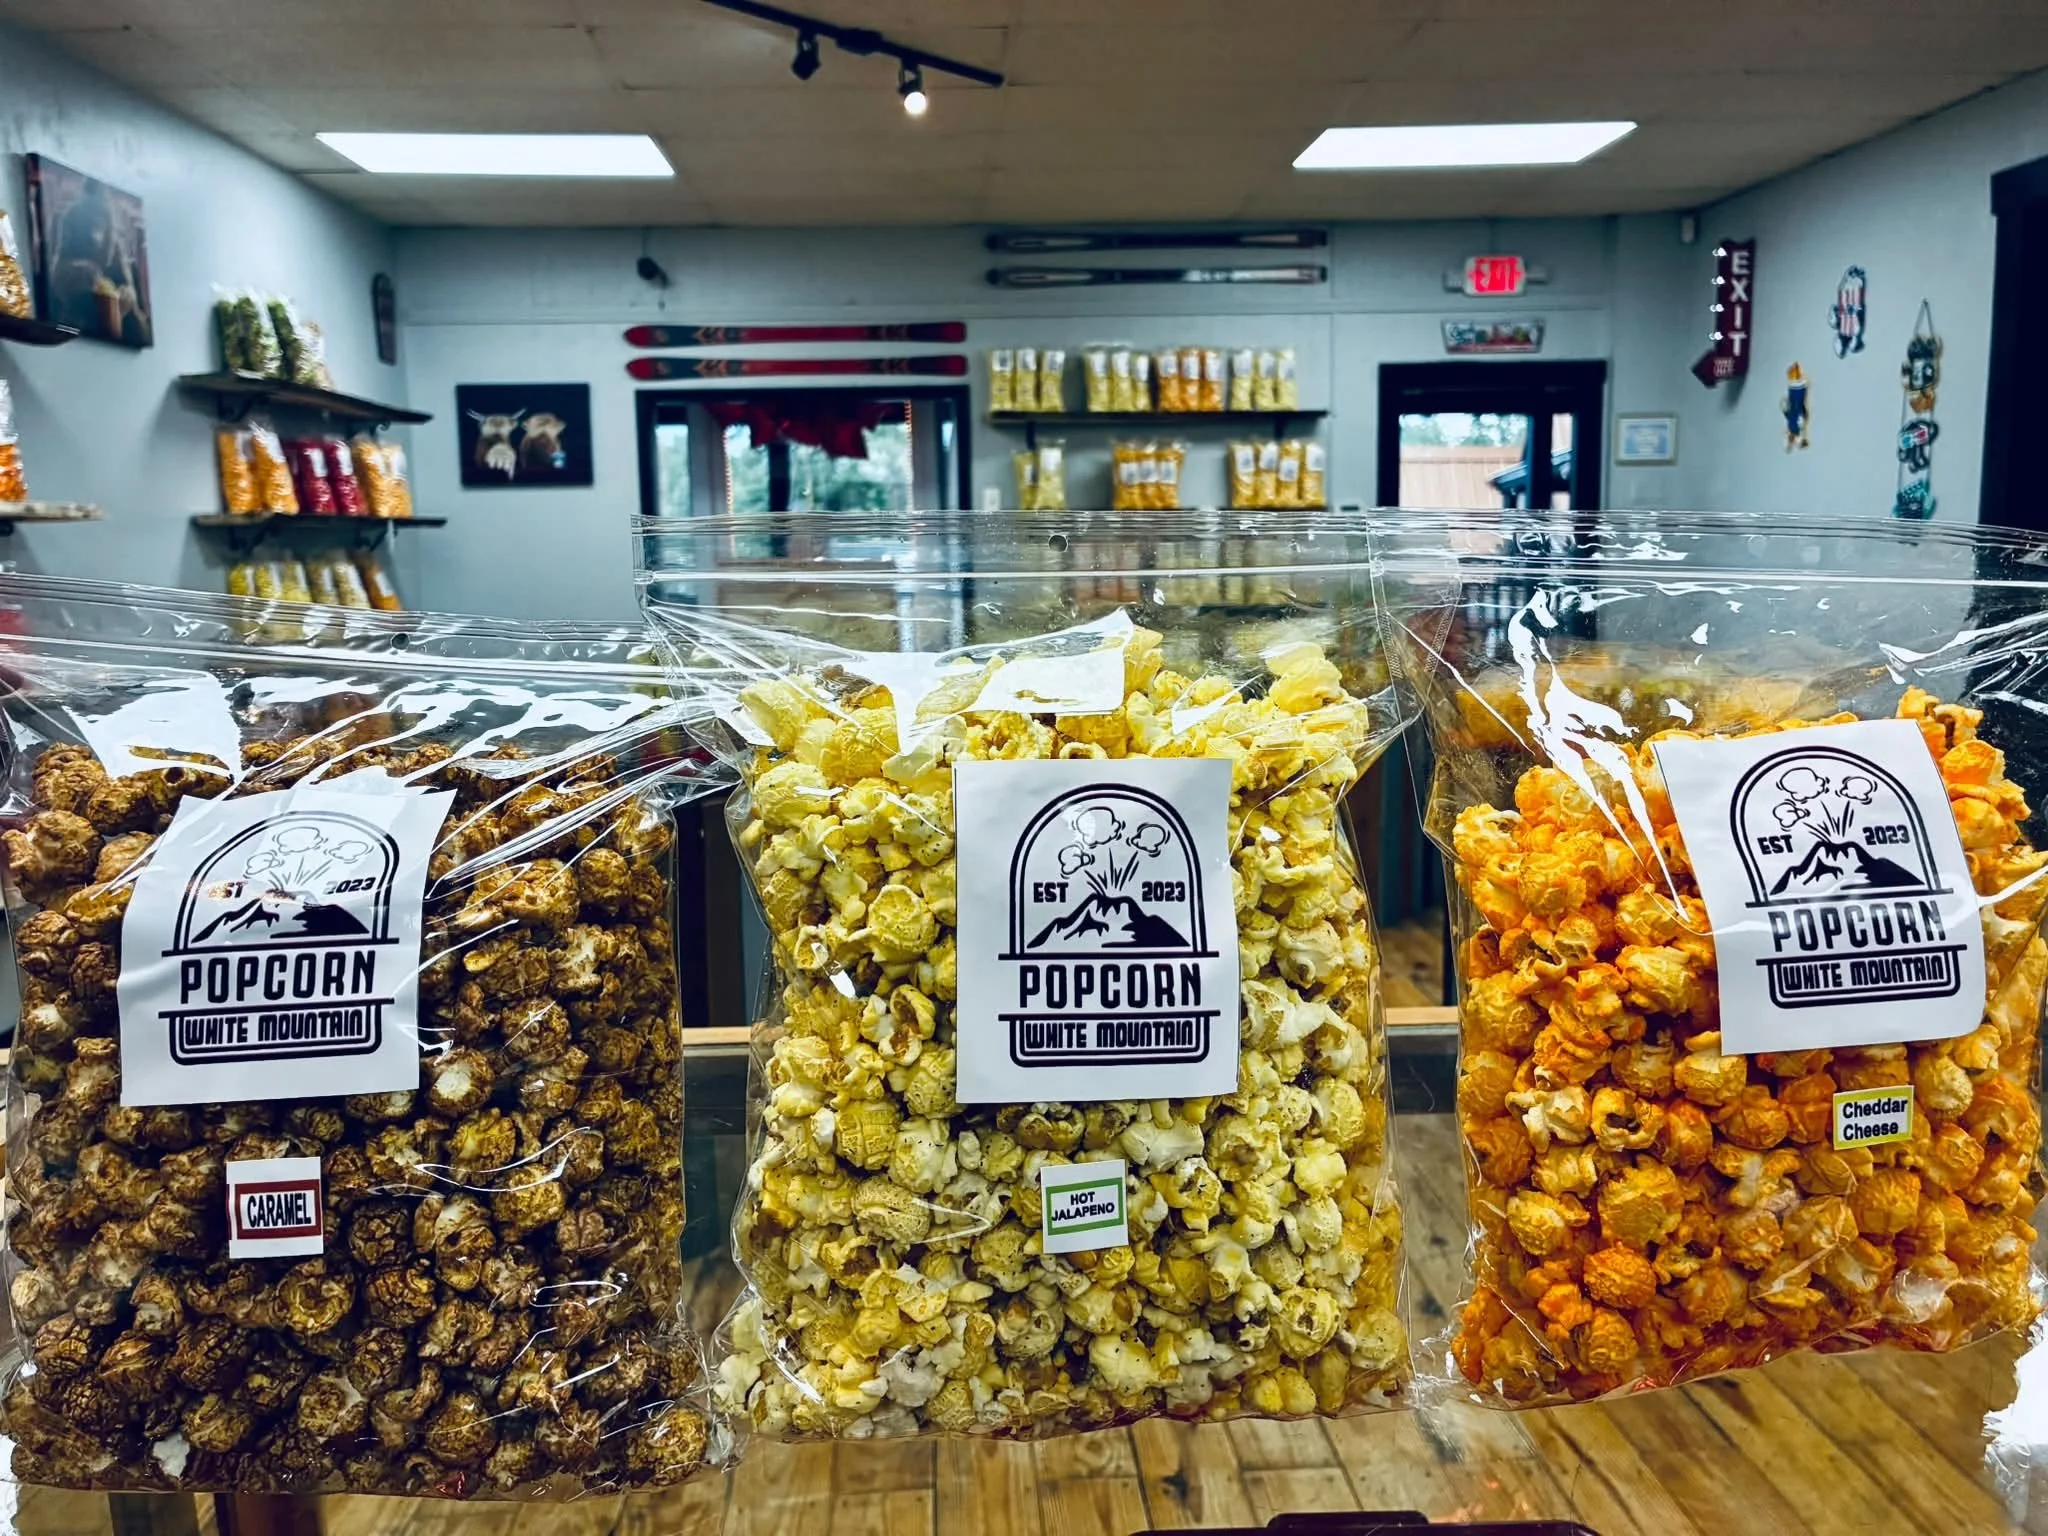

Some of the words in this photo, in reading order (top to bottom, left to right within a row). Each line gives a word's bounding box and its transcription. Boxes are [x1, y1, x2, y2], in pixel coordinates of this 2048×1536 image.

[1729, 251, 1750, 356] EXIT
[1757, 834, 1793, 855] EST
[1863, 825, 1910, 846] 2023
[208, 881, 246, 899] ST
[323, 877, 376, 895] 2023
[1033, 880, 1068, 903] EST
[1141, 880, 1186, 903] 2023
[1768, 900, 1946, 953] POPCORN
[180, 950, 376, 1004] POPCORN
[1019, 962, 1201, 1009] POPCORN
[1782, 961, 1843, 991] WHITE
[1851, 954, 1945, 985] MOUNTAIN
[184, 1016, 248, 1046] WHITE
[258, 1009, 363, 1042] MOUNTAIN
[1024, 1021, 1087, 1050] WHITE
[1096, 1020, 1194, 1049] MOUNTAIN
[1843, 1098, 1908, 1120] Cheddar
[1843, 1121, 1899, 1141] Cheese
[247, 1192, 312, 1229] CARAMEL
[1051, 1202, 1115, 1222] JALAPENO
[1070, 1192, 1095, 1206] HOT
